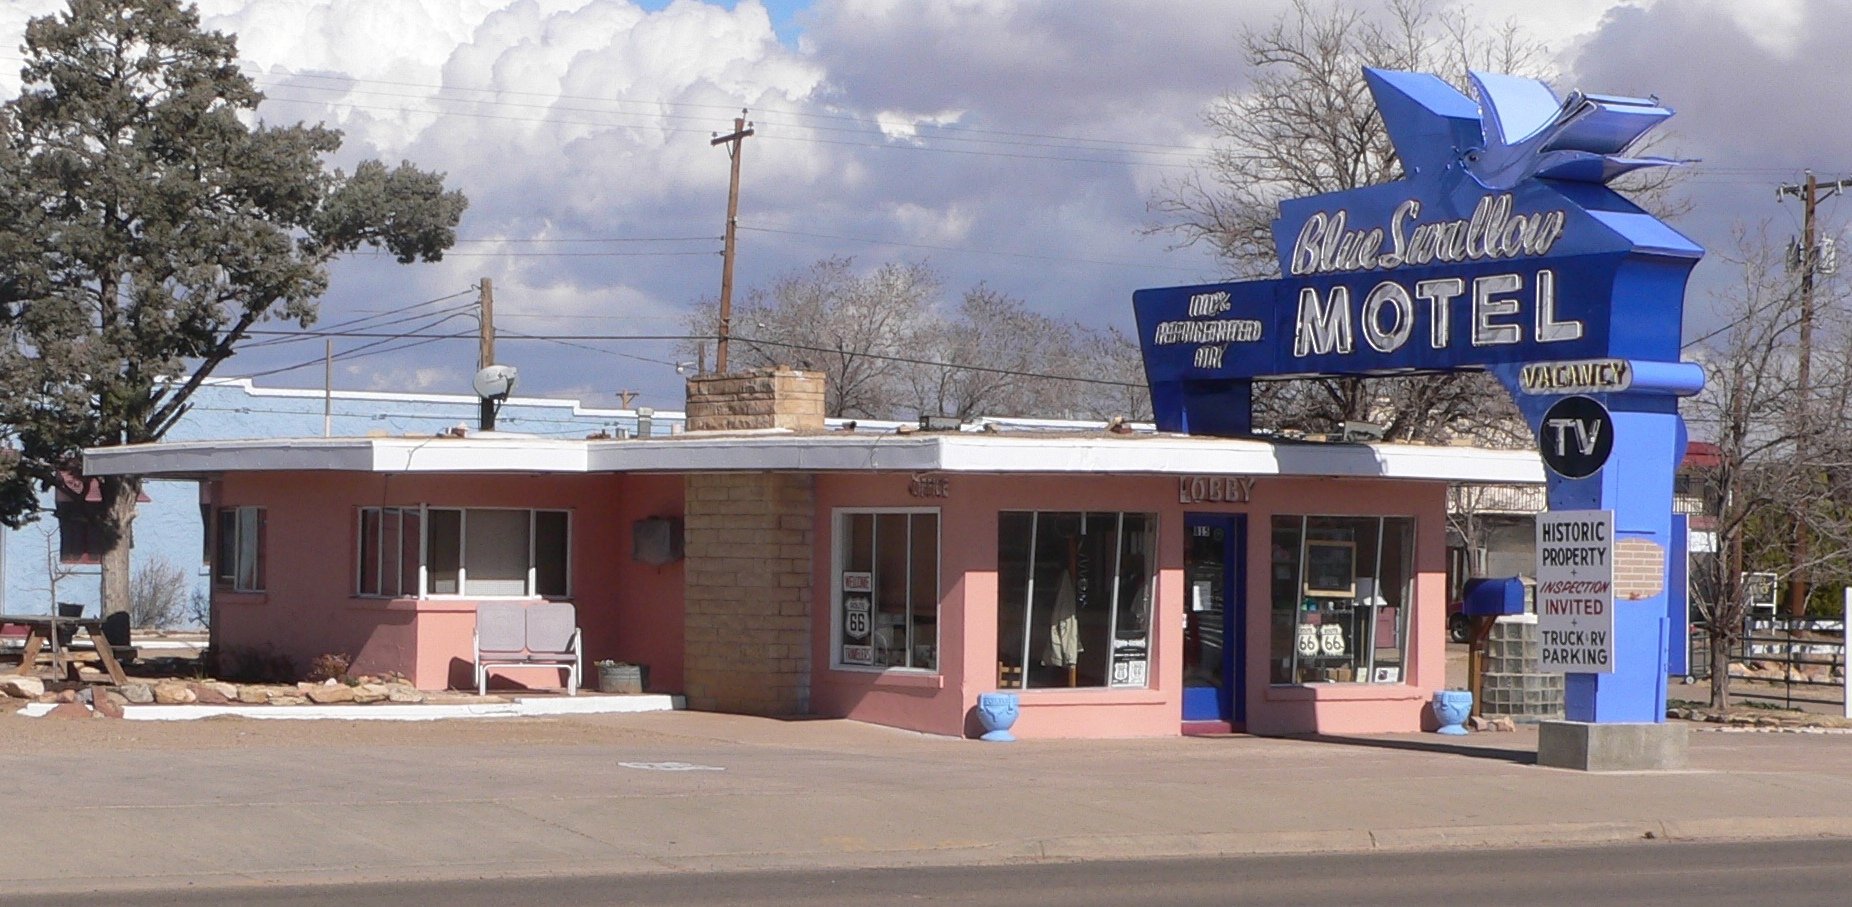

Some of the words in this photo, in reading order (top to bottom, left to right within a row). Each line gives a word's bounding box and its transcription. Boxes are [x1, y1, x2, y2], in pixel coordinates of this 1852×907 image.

[1291, 210, 1384, 275] Blue
[1378, 193, 1565, 268] Swallow
[1188, 291, 1231, 317] 100%
[1294, 269, 1583, 357] MOTEL
[1155, 320, 1262, 345] REFRIGERATED
[1194, 344, 1228, 368] AIR
[1522, 361, 1627, 389] VACANCY
[1546, 418, 1602, 456] TV
[1179, 475, 1255, 503] LOBBY
[1542, 521, 1605, 542] HISTORIC
[1542, 547, 1606, 567] PROPERTY
[1540, 581, 1609, 594] INSPECTION
[1545, 599, 1603, 615] INVITED
[850, 613, 864, 631] 66
[1299, 636, 1315, 650] 66
[1325, 636, 1342, 650] 66
[1542, 631, 1584, 646] TRUCK
[1590, 631, 1606, 646] RV
[1542, 648, 1608, 665] PARKING
